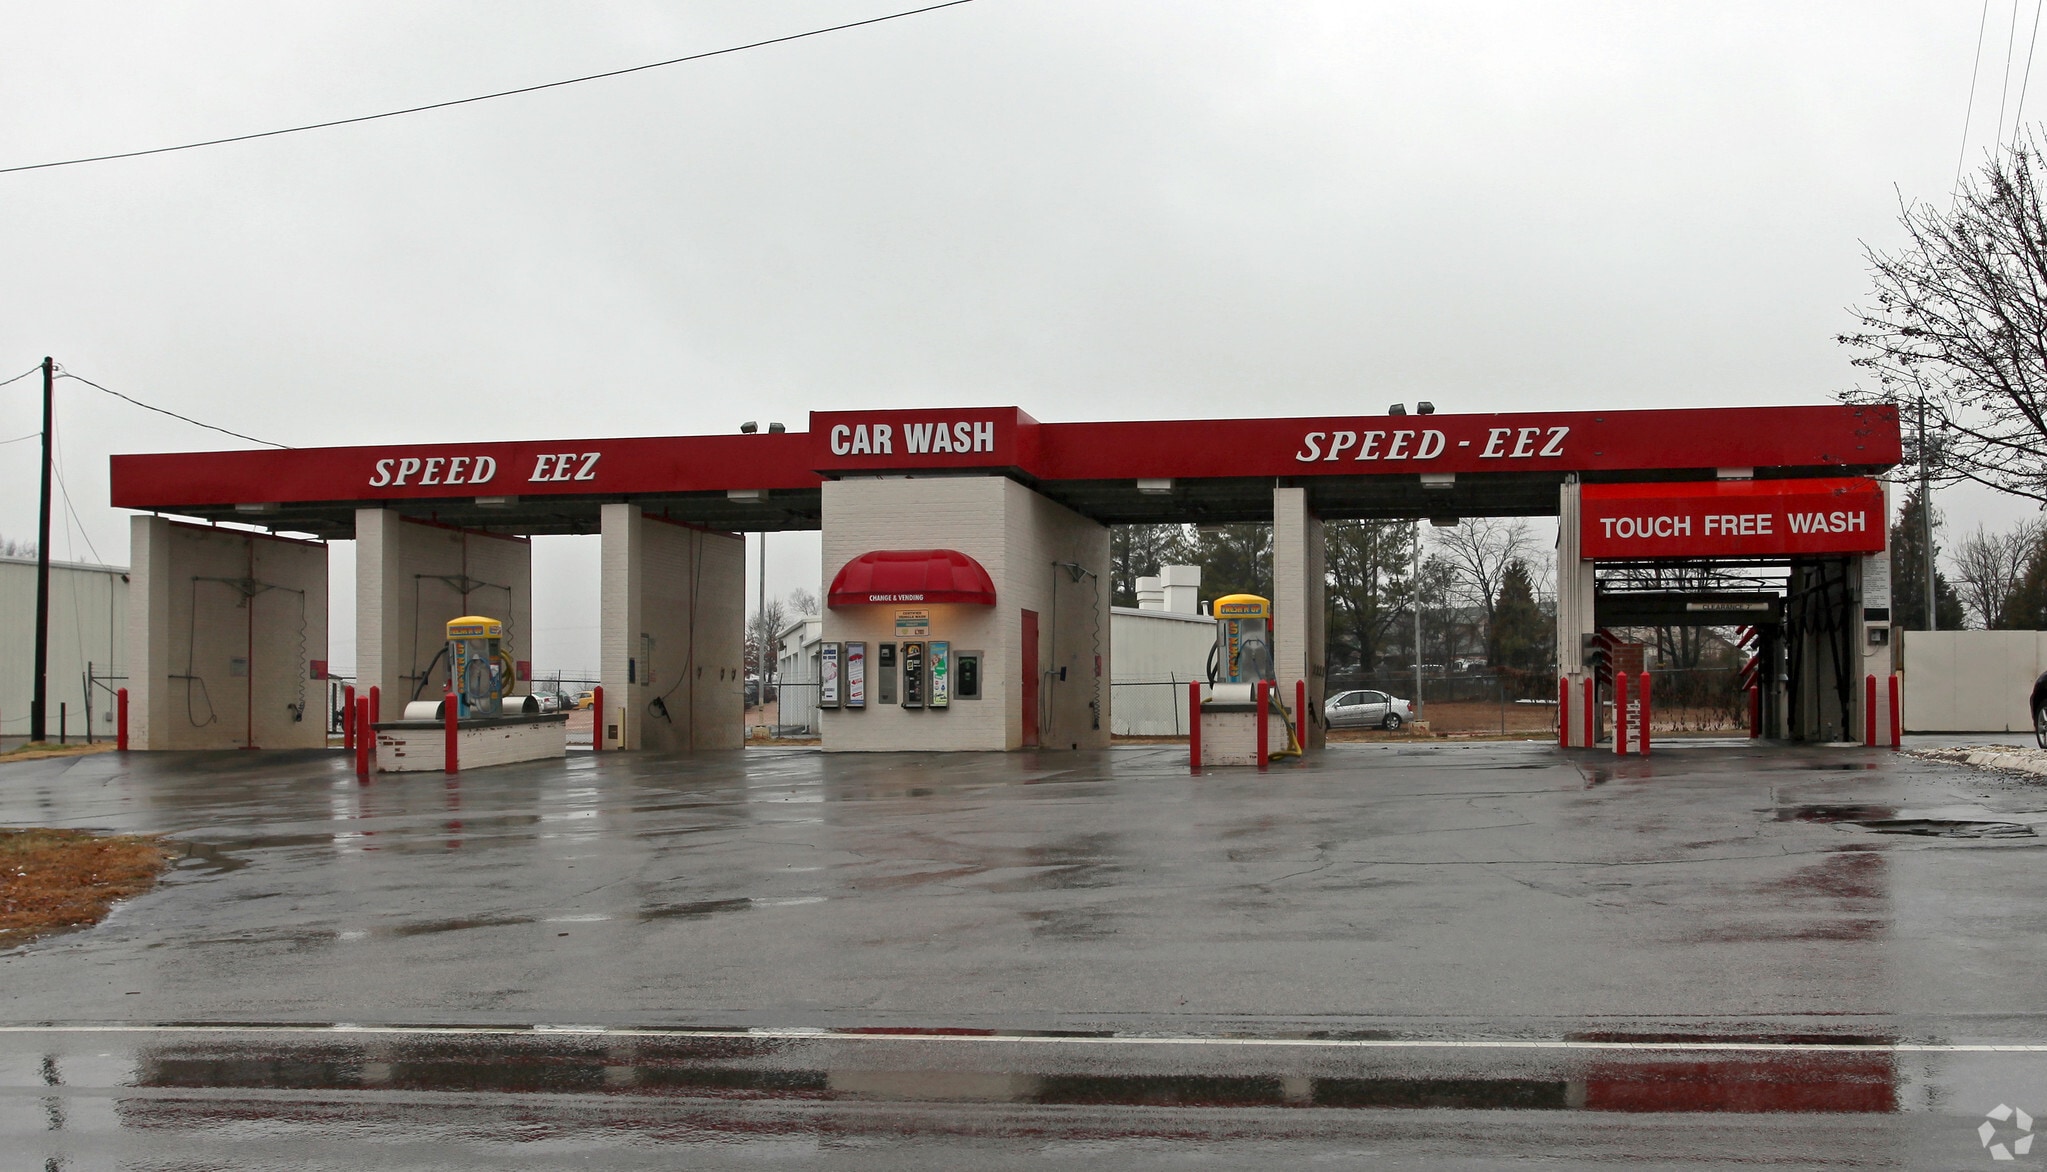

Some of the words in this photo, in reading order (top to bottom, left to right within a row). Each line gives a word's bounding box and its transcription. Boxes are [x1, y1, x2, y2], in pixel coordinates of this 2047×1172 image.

[830, 424, 893, 456] CAR
[903, 421, 994, 454] WASH
[1296, 429, 1446, 463] SPEED
[1479, 426, 1570, 458] EEZ
[368, 456, 497, 487] SPEED
[527, 452, 601, 482] EEZ
[1600, 517, 1691, 538] TOUCH
[1704, 514, 1773, 536] FREE
[1787, 511, 1866, 534] WASH
[1702, 603, 1743, 611] CLEARANCE
[1228, 621, 1239, 635] UP
[456, 643, 465, 655] UP
